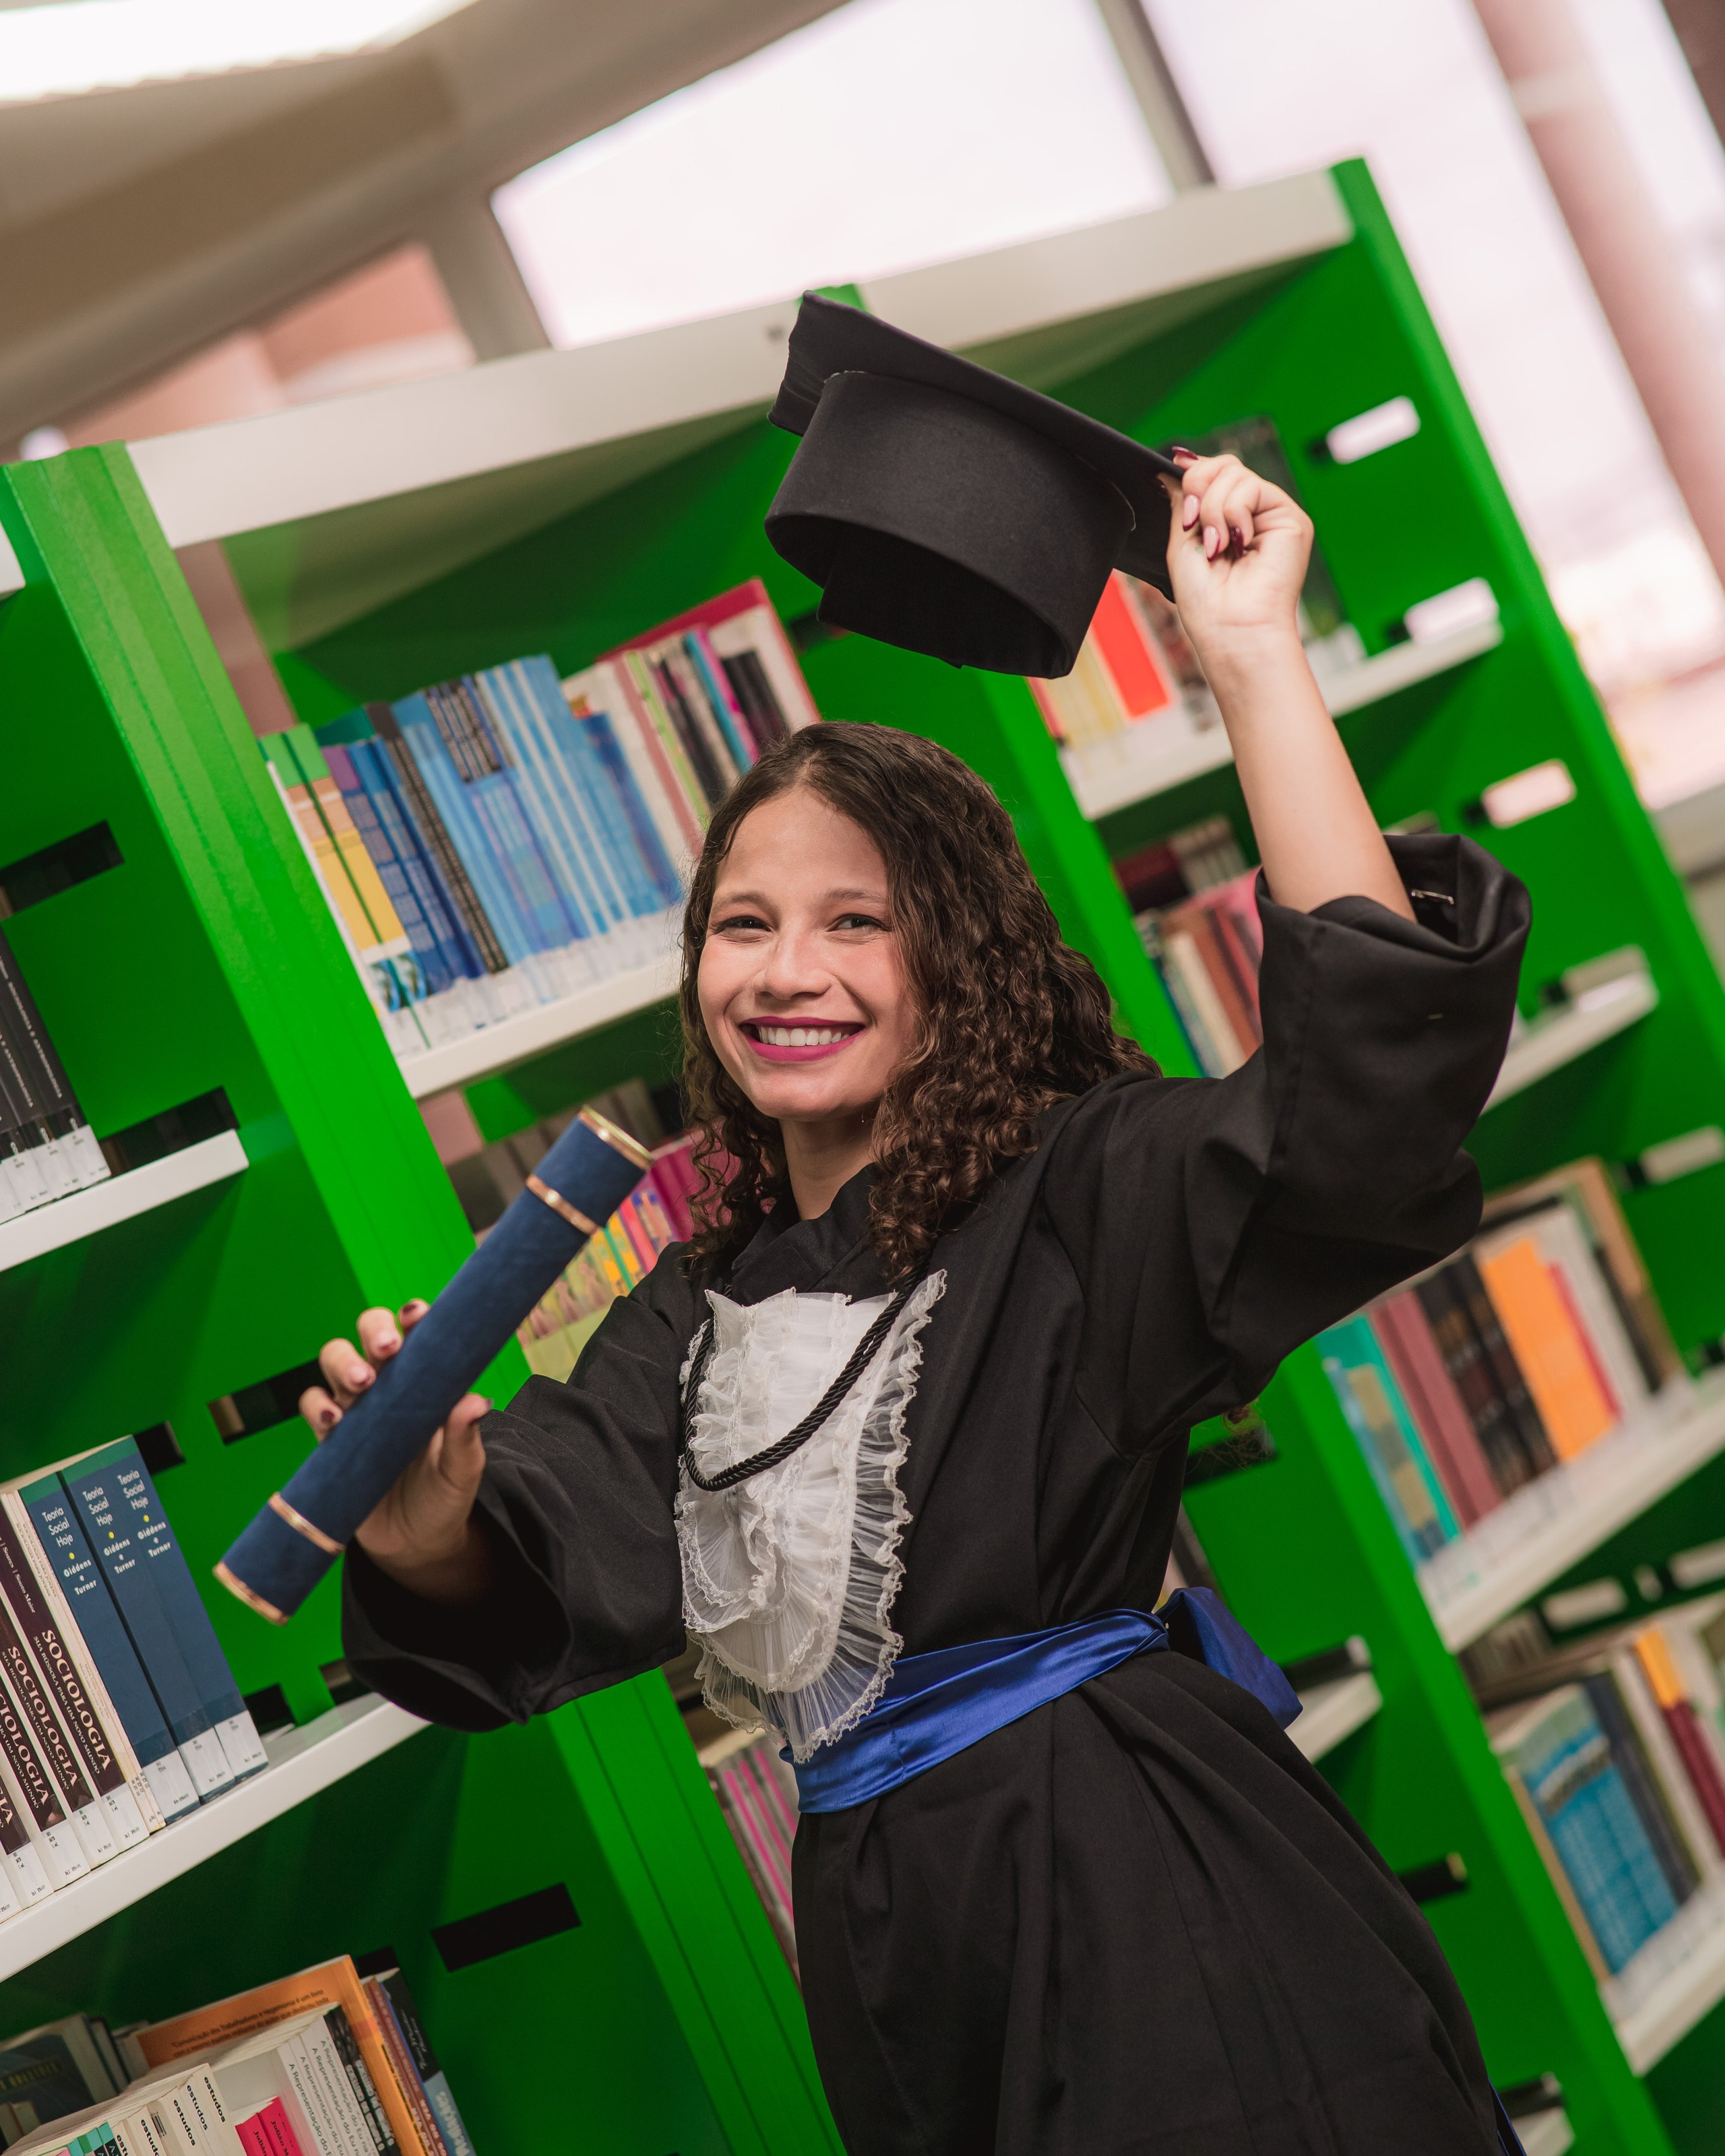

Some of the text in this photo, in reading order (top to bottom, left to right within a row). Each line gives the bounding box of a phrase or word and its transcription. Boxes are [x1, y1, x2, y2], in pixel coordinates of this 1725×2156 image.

[117, 1469, 140, 1485] Teoria
[82, 1486, 104, 1502] Teoria
[123, 1480, 145, 1498] Social
[88, 1496, 109, 1515] Social
[130, 1496, 149, 1511] Hoje
[42, 1507, 65, 1523] Teoria
[96, 1513, 113, 1527] Hoje
[49, 1517, 70, 1535] Social
[137, 1521, 166, 1540] Giddens
[56, 1533, 73, 1548] Hoje
[103, 1538, 130, 1556] Giddens
[148, 1542, 171, 1557] Turner
[63, 1559, 92, 1577] Giddens
[114, 1558, 135, 1574] Turner
[3, 1547, 35, 1613] Soares Souto Maior
[74, 1579, 97, 1595] Turner
[34, 1636, 100, 1775] SUA BÚSSOLA PARA UM NOVO MUNDO
[42, 1629, 111, 1771] SOCIOLOGIA
[1, 1651, 11, 1667] SUA
[25, 1702, 36, 1721] PARA
[35, 1721, 44, 1736] UM
[42, 1736, 55, 1759] NOVO
[53, 1758, 69, 1789] MUNDO
[7, 1646, 78, 1787] SOCIOLOGIA
[5, 1740, 13, 1754] UM
[12, 1754, 24, 1777] NOVO
[23, 1778, 38, 1808] MUNDO
[203, 2075, 226, 2123] estudos
[305, 2064, 334, 2129] Representação
[332, 2130, 338, 2143] do
[315, 2055, 345, 2121] Representação
[344, 2122, 351, 2134] do
[349, 2133, 356, 2147] Eu
[324, 2048, 353, 2114] Representação
[351, 2114, 358, 2127] do
[356, 2126, 363, 2140] Eu
[186, 2084, 209, 2130] estudos
[292, 2071, 322, 2137] Representação
[320, 2137, 327, 2151] do
[172, 2098, 197, 2147] estudos
[270, 2120, 285, 2146] Julián
